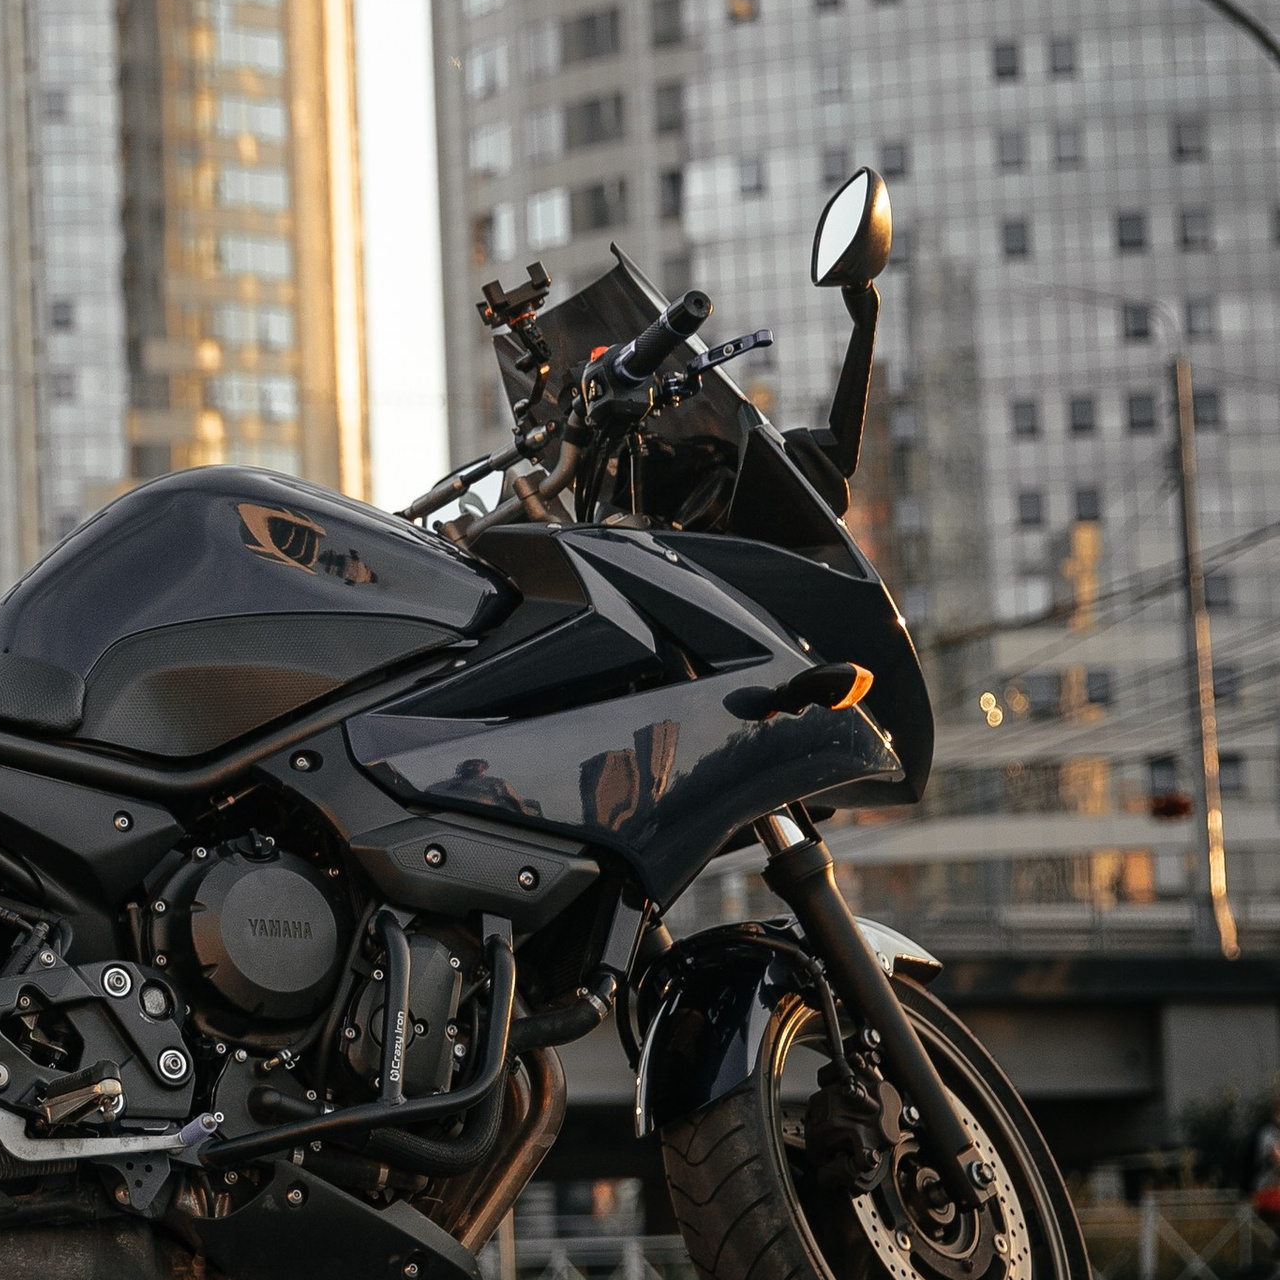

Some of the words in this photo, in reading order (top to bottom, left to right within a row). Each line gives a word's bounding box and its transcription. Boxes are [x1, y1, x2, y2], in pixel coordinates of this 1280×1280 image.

[248, 918, 314, 940] YAMAHA
[394, 1010, 405, 1034] Iron
[391, 1035, 405, 1069] Crazy
